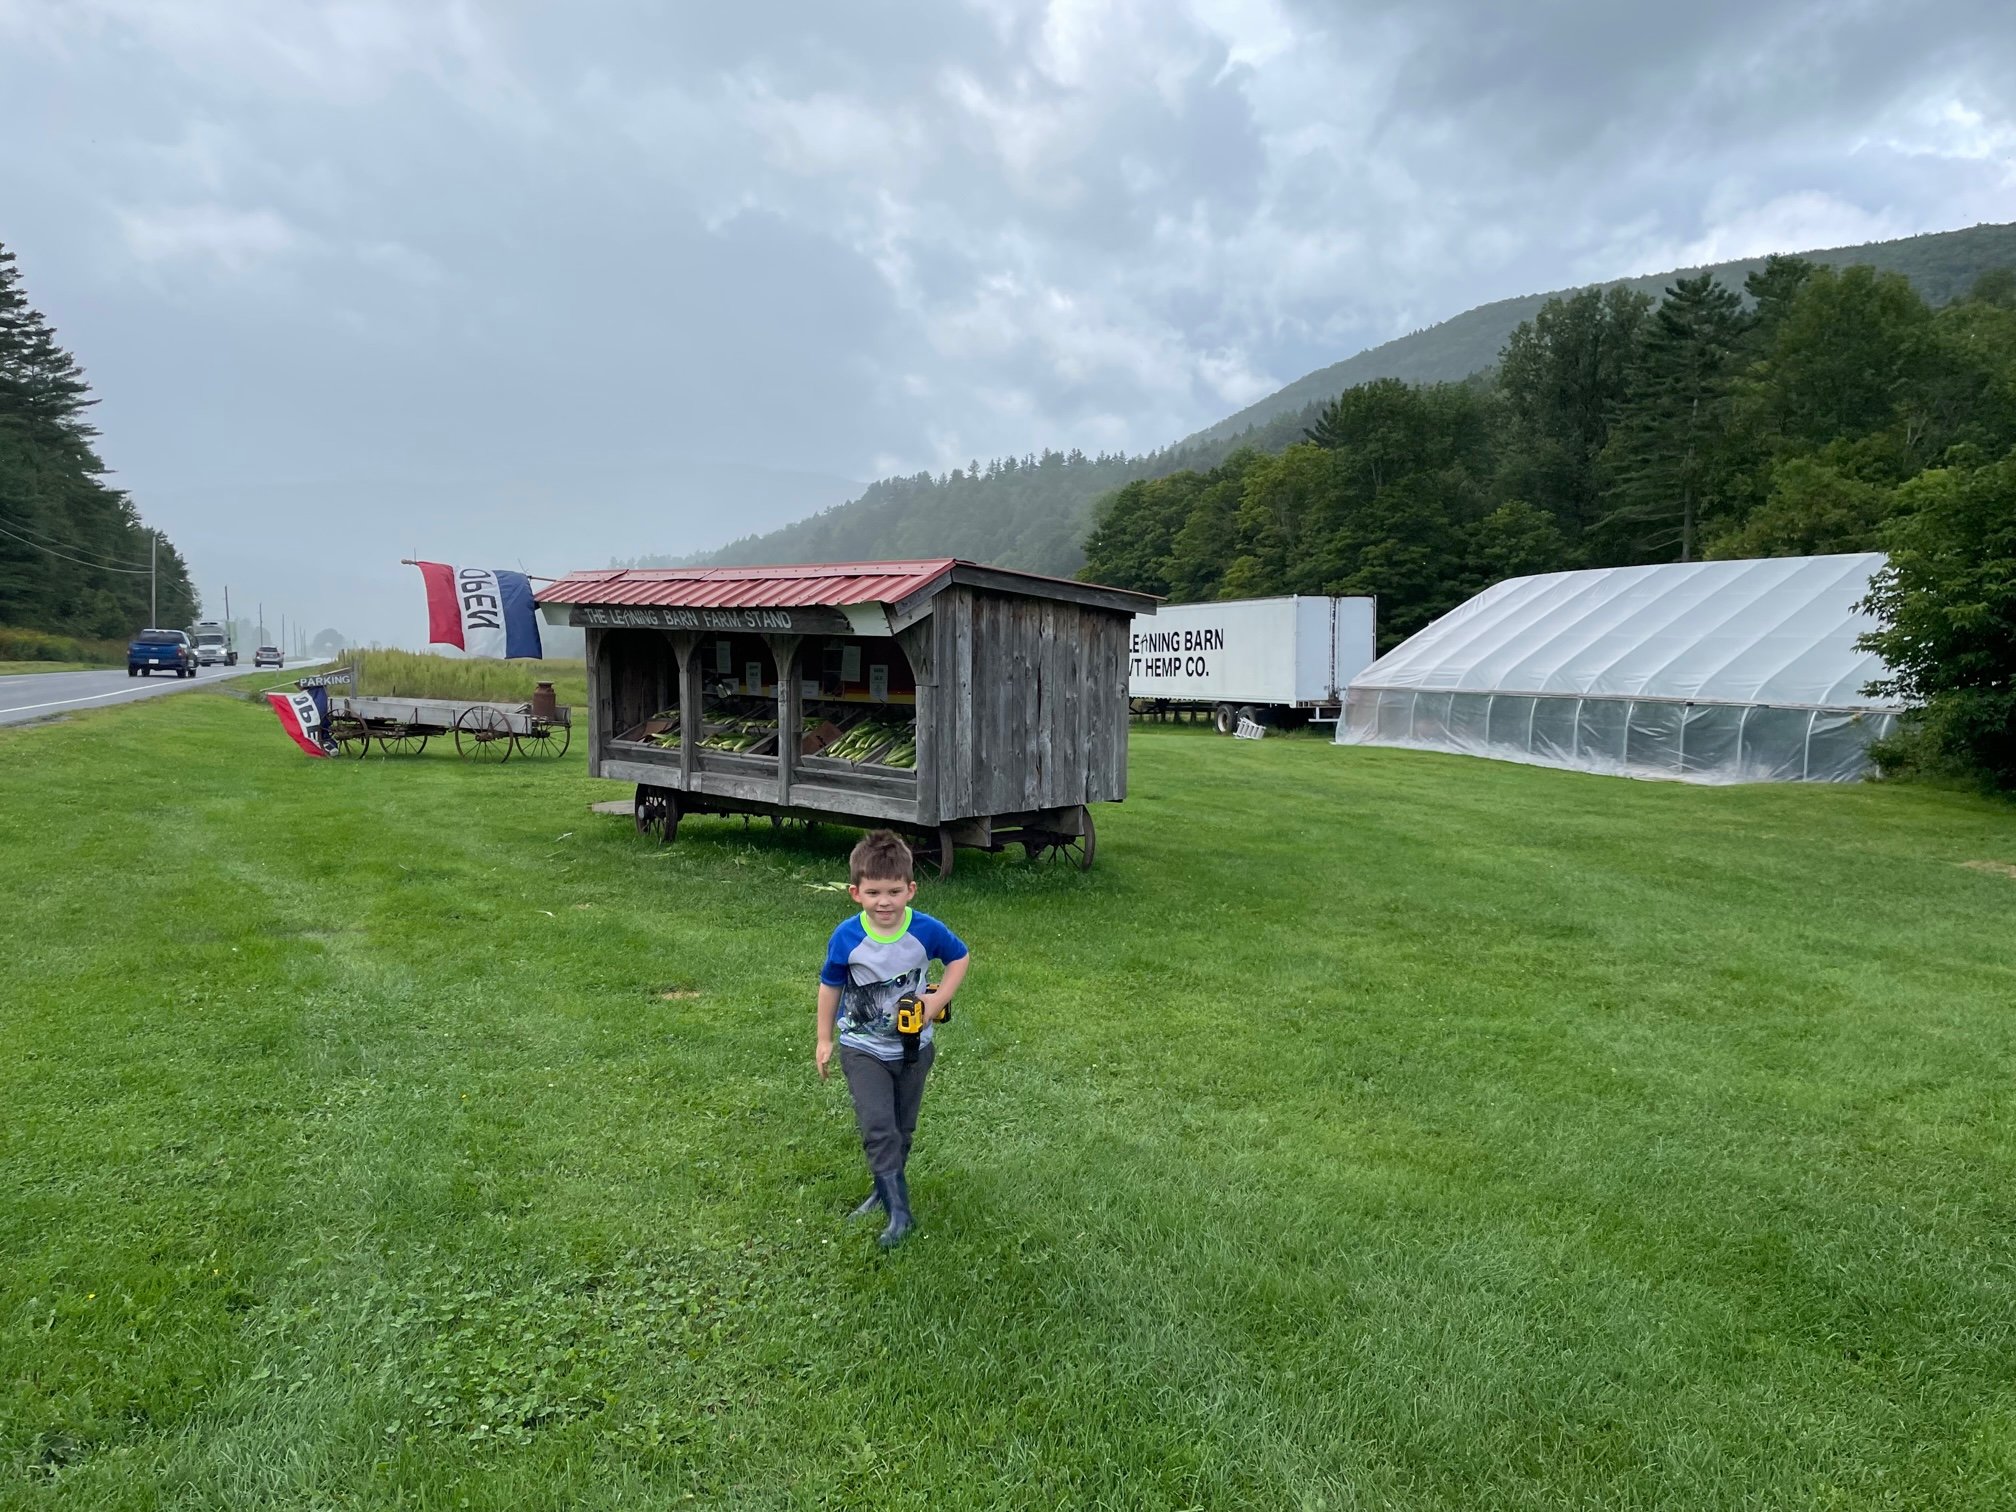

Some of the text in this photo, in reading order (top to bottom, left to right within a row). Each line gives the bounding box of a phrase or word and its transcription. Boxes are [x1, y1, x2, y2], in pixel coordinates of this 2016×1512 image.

[584, 608, 792, 629] THE LEANING BARN FARM STAND
[1129, 628, 1224, 654] EANING BARN
[1145, 657, 1182, 677] HEMP
[1185, 656, 1209, 677] CO.
[300, 675, 351, 687] PARKING
